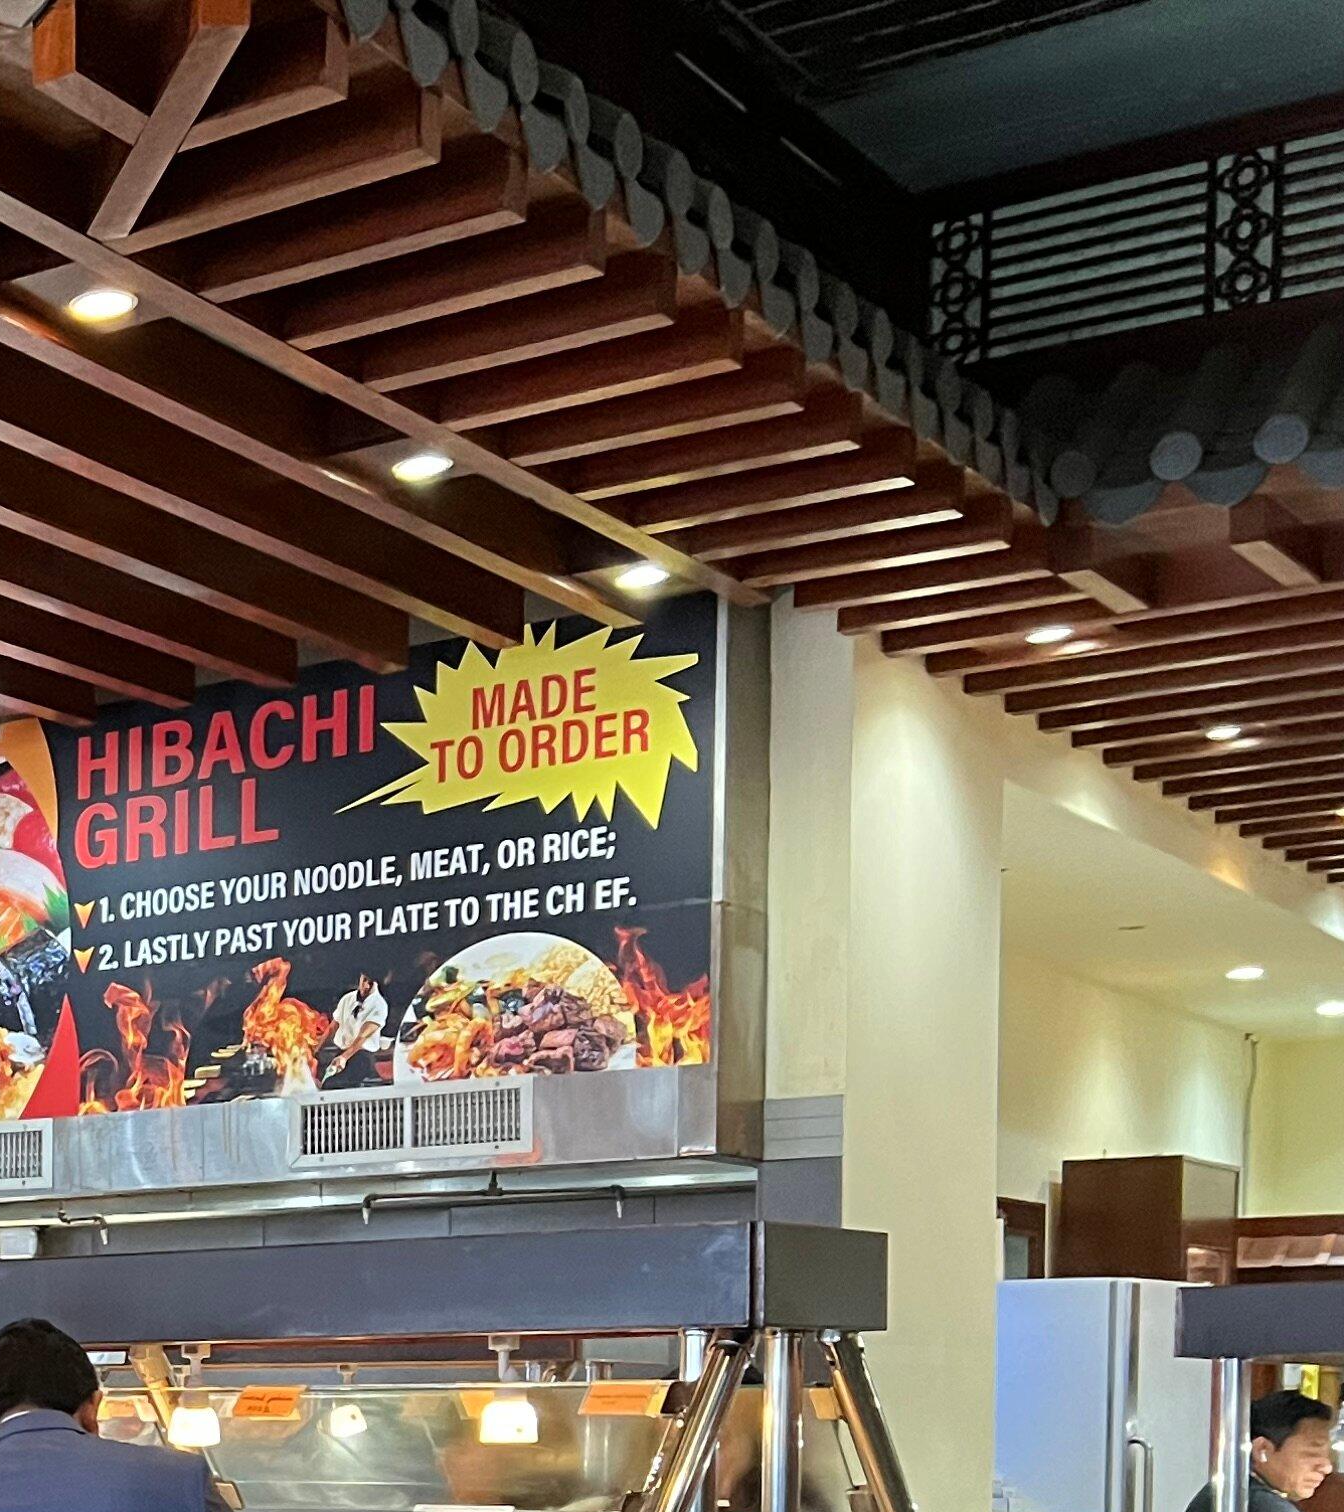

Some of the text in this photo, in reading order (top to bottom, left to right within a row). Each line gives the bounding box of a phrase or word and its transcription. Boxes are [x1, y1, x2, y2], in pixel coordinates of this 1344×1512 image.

[77, 684, 375, 800] HIBACHI
[471, 667, 597, 730] MADE
[430, 708, 650, 784] TO ORDER
[74, 778, 280, 869] GRILL
[99, 825, 618, 924] 1. CHOOSE YOUR NOODLE, MEAT, OR RICE;
[98, 876, 638, 971] 2. LASTLY PAST YOUR PLATE TO THE CH EF.
